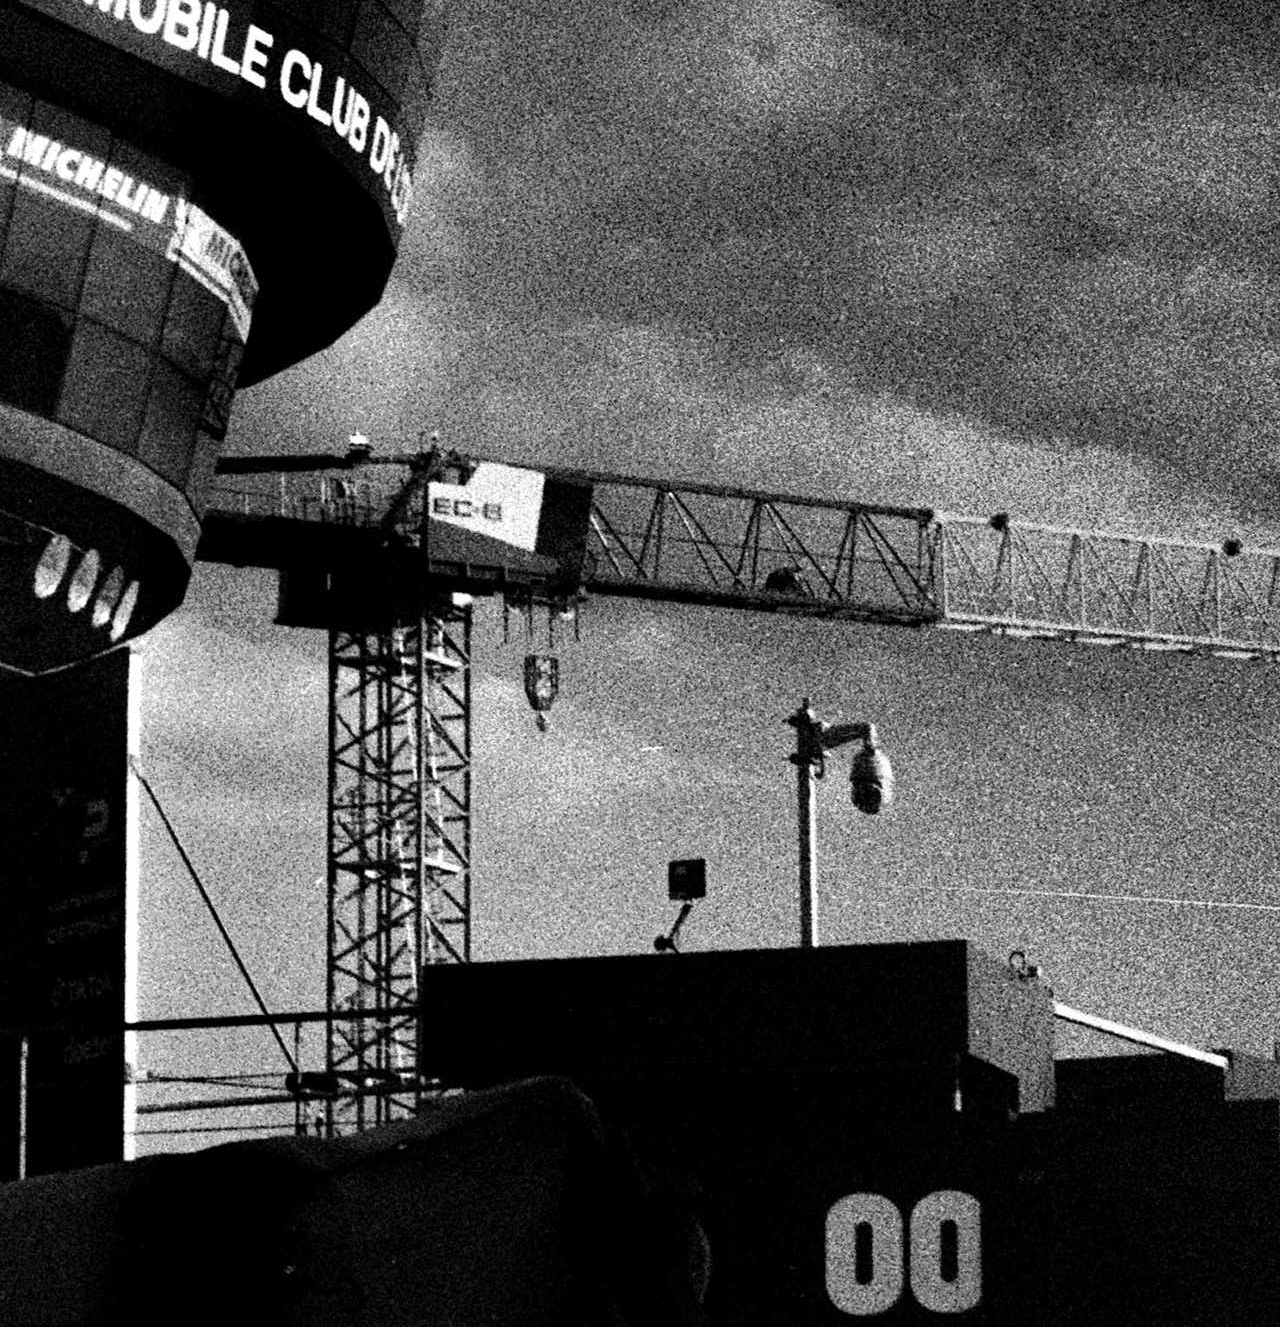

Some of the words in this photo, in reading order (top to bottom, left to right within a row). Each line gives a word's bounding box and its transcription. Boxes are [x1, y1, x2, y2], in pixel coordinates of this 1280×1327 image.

[280, 49, 371, 154] CLUB
[7, 126, 170, 224] MICHELIN
[825, 1189, 982, 1316] 00
